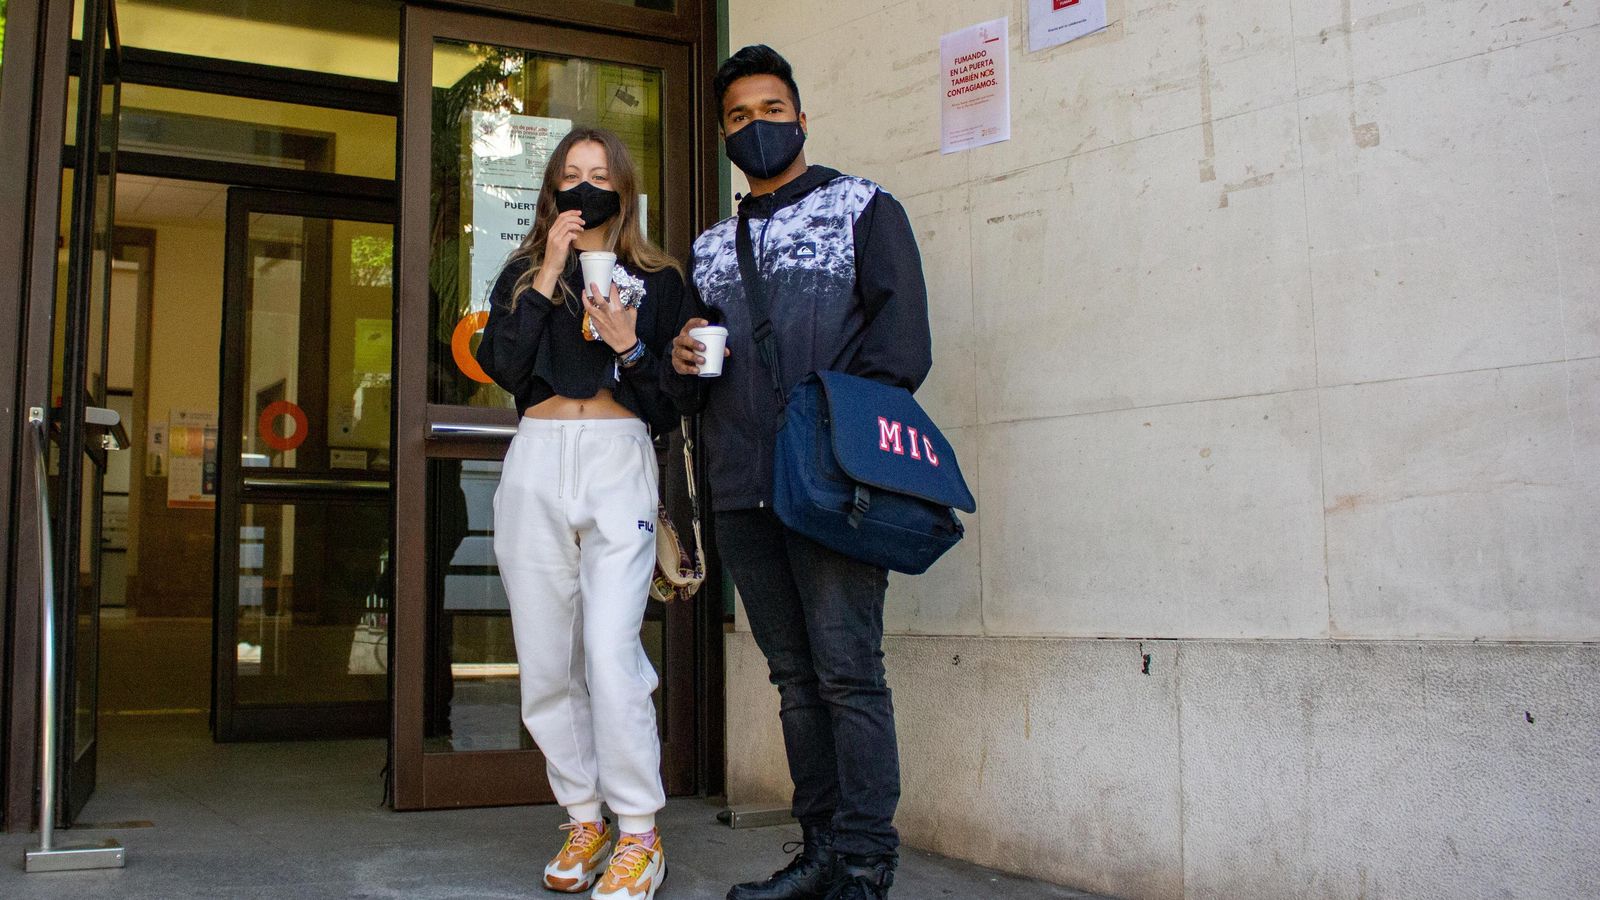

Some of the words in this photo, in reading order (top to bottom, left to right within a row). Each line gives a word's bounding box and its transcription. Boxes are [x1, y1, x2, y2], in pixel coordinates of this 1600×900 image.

[954, 50, 987, 65] FUMANDO
[950, 69, 959, 77] EN
[960, 66, 969, 74] LA
[969, 58, 994, 71] PUERTA
[951, 72, 979, 86] TAMBIÉN
[980, 69, 995, 79] NOS
[947, 79, 998, 98] CONTAGIAMOS.
[504, 202, 537, 210] PUERT
[517, 218, 530, 226] DE
[500, 233, 527, 241] ENTR
[637, 520, 654, 533] FILA
